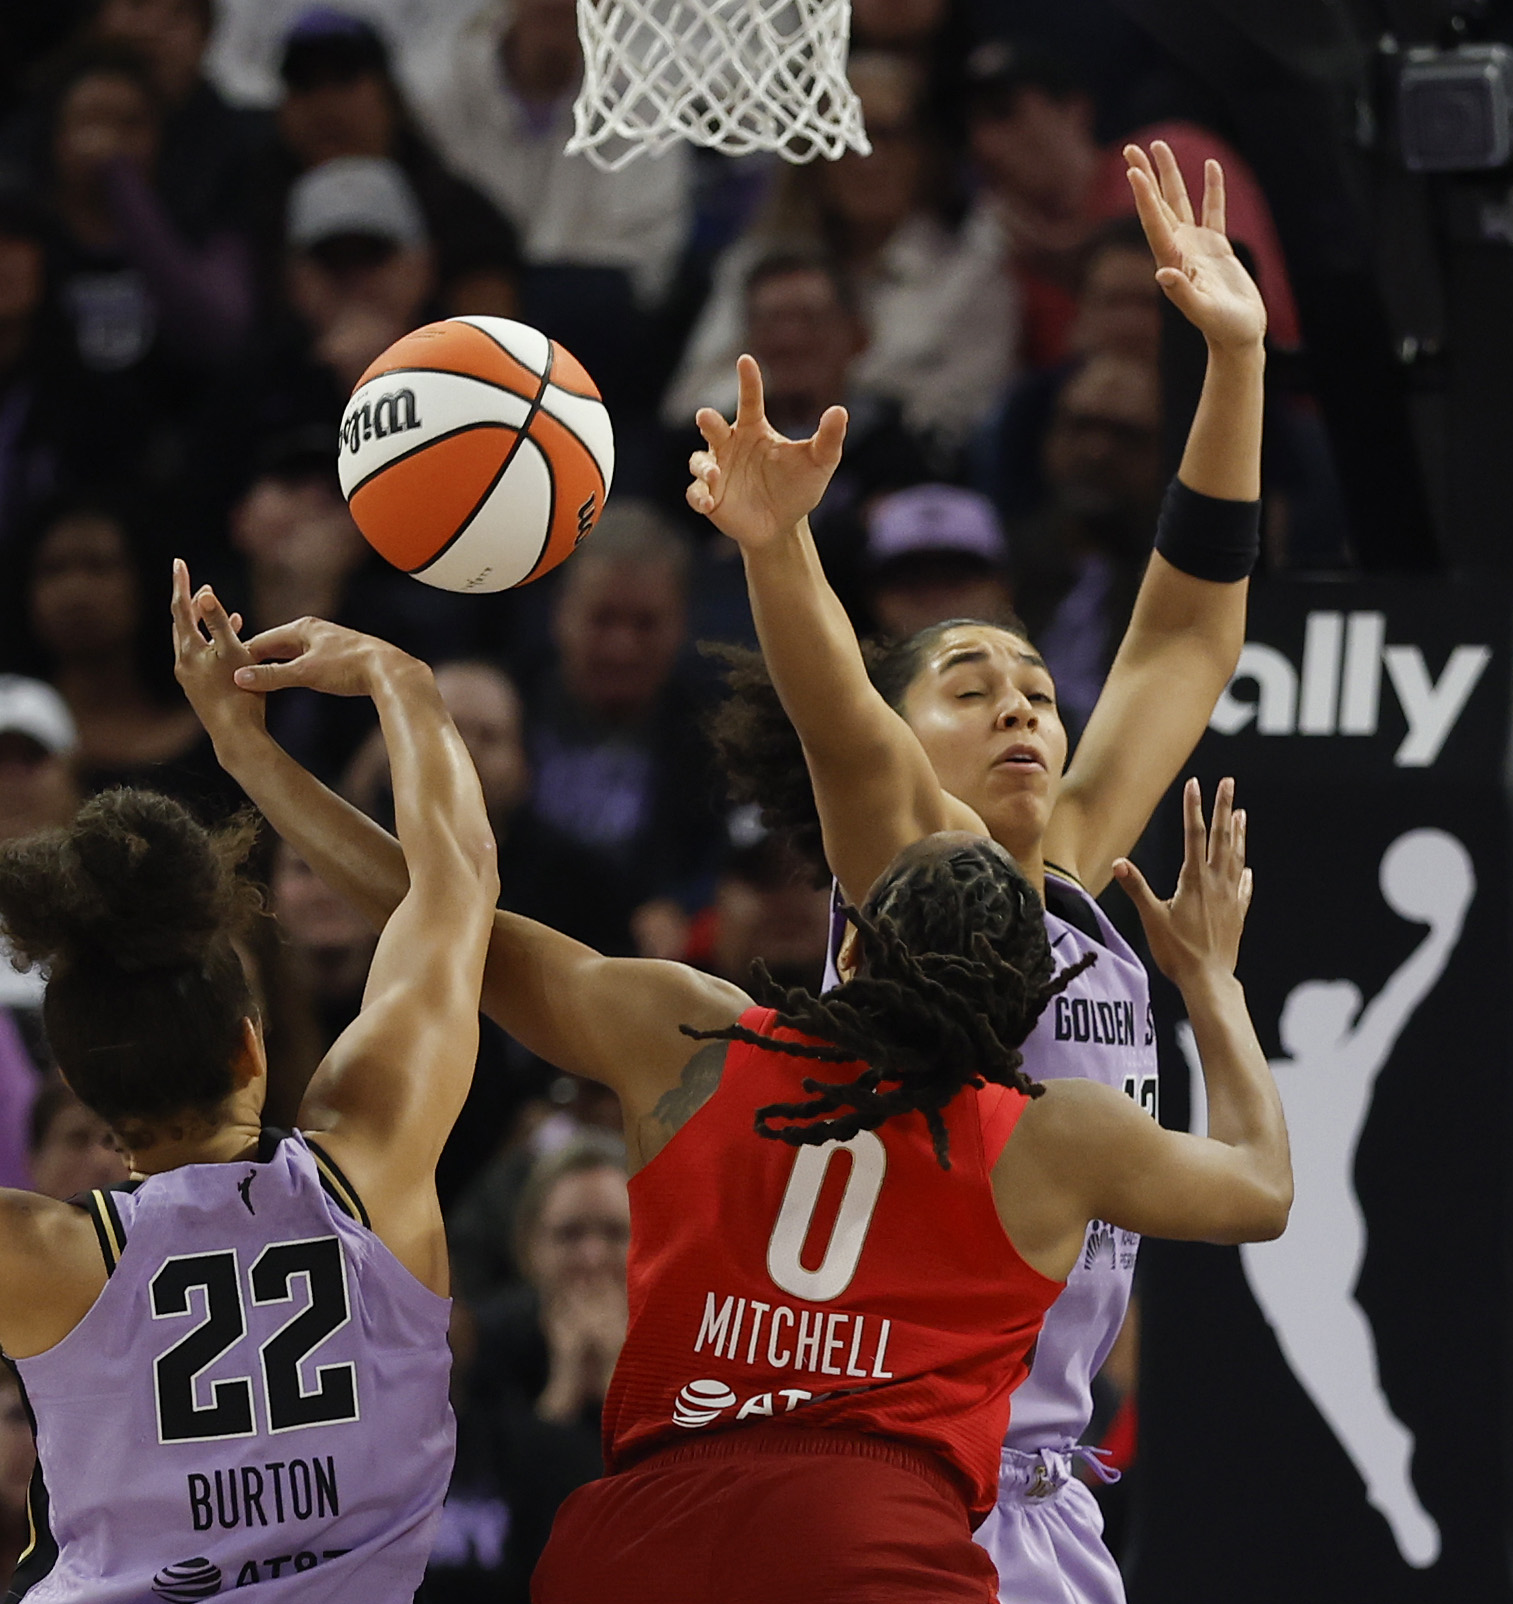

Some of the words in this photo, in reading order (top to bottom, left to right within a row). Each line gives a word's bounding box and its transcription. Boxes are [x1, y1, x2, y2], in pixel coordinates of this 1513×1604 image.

[1208, 611, 1491, 767] ally
[1055, 996, 1135, 1046] GOLDEN
[766, 1125, 887, 1302] 0
[148, 1234, 360, 1445] 22
[693, 1291, 893, 1379] MITCHELL
[187, 1456, 339, 1531] BURTON
